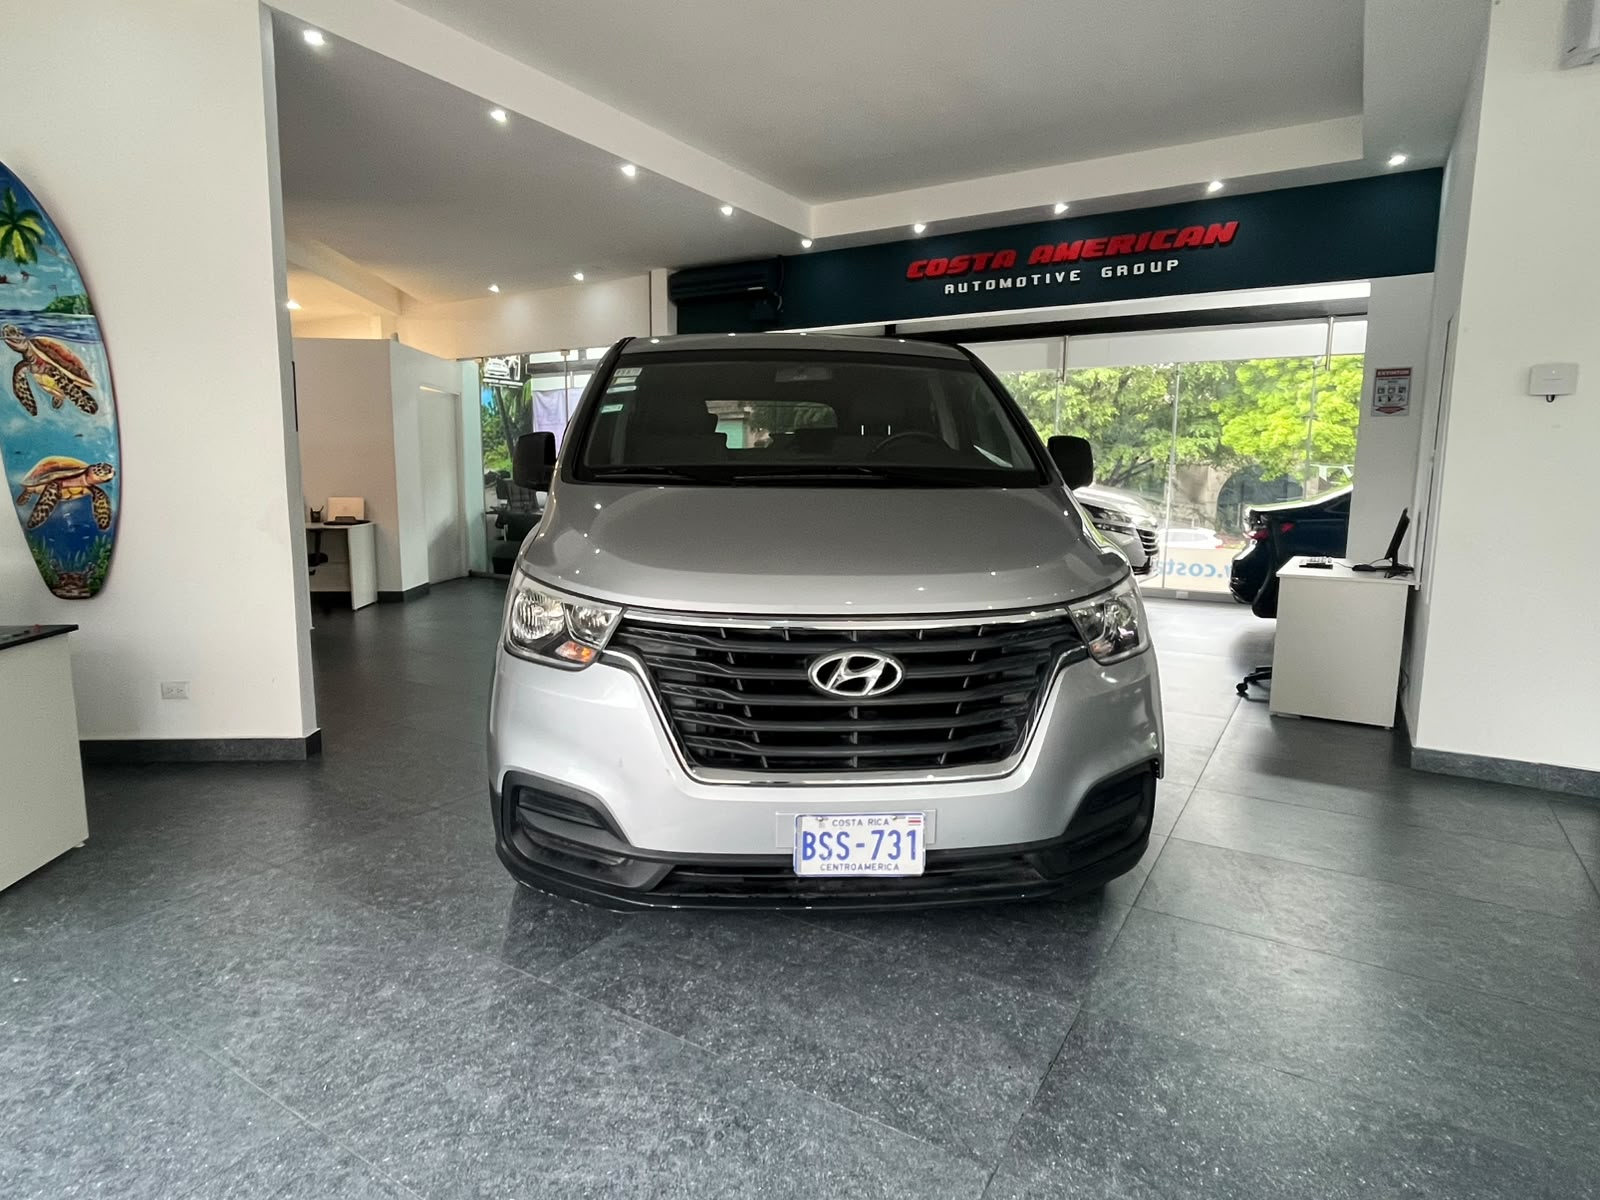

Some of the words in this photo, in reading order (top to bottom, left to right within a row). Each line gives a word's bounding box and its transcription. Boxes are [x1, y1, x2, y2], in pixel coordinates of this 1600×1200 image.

[906, 249, 1018, 280] COSTA
[1027, 221, 1240, 266] AMERICAN
[944, 270, 1081, 295] AUTOMOTIVE
[1101, 259, 1179, 278] GROUP
[832, 818, 863, 827] COSTA
[867, 818, 890, 826] RICA
[802, 829, 917, 861] BSS-731
[820, 862, 900, 871] CENTROAMERICA
